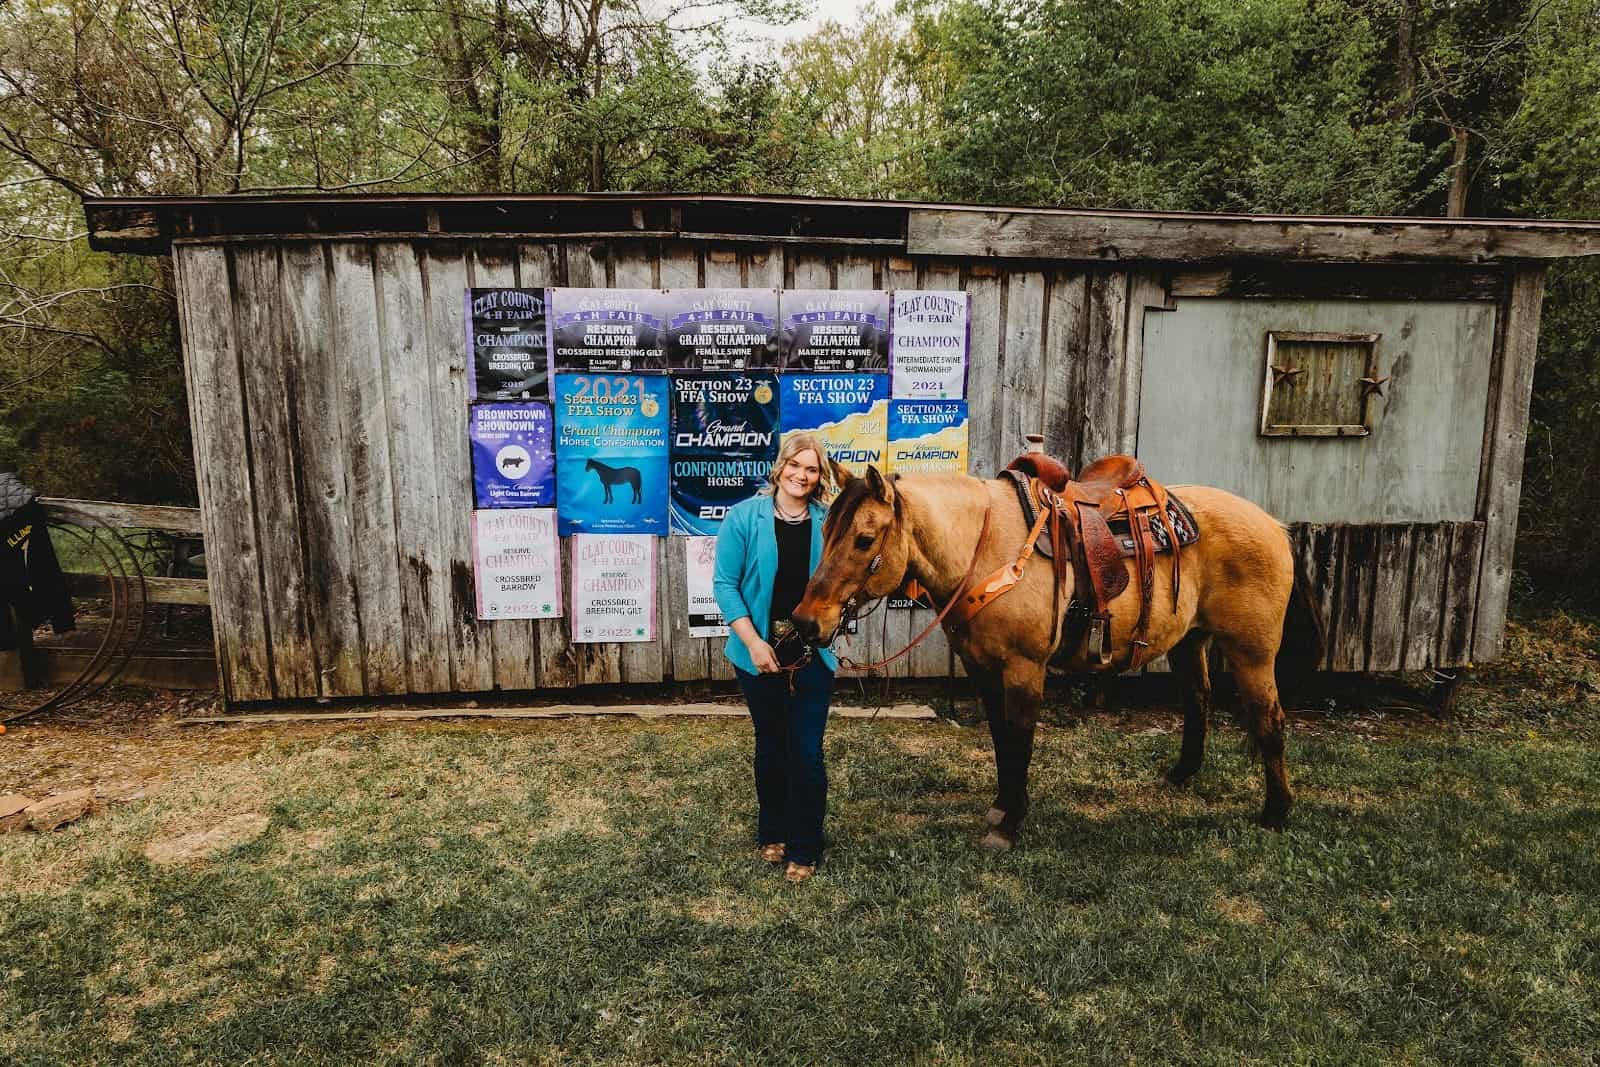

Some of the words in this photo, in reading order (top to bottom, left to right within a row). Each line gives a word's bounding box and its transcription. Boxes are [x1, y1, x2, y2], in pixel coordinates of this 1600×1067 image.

[474, 292, 498, 315] CLAY
[501, 290, 543, 315] COUNTY
[898, 297, 921, 318] CLAY
[924, 296, 963, 316] COUNTY
[484, 310, 503, 320] 4-H
[507, 310, 533, 320] FAIR
[574, 311, 600, 320] 4-H
[609, 311, 643, 321] FAIR
[688, 311, 713, 321] 4-H
[721, 311, 754, 321] FAIR
[801, 313, 825, 322] 4-H
[835, 312, 866, 322] FAIR
[928, 314, 952, 323] FAIR
[586, 324, 633, 334] RESERVE
[700, 324, 745, 334] RESERVE
[812, 325, 857, 334] RESERVE
[477, 334, 544, 347] CHAMPION
[583, 335, 636, 346] CHAMPION
[679, 334, 712, 346] GRAND
[716, 334, 767, 346] CHAMPION
[809, 335, 860, 346] CHAMPION
[898, 336, 960, 348] CHAMPION
[492, 353, 530, 361] CROSSBRED
[557, 348, 604, 356] CROSSBRED
[606, 349, 645, 357] BREEDING
[646, 349, 664, 357] GILT
[695, 348, 726, 356] FEMALE
[726, 348, 752, 356] SWINE
[798, 348, 830, 356] MARKET
[897, 356, 940, 364] INTERMEDIATE
[940, 356, 961, 364] SWINE
[488, 361, 521, 371] BREEDING
[522, 361, 535, 371] GILT
[575, 377, 645, 400] 2021
[735, 378, 752, 390] 23
[793, 378, 854, 391] SECTION
[858, 379, 874, 391] 23
[912, 382, 944, 390] 2021
[622, 394, 637, 405] 23
[680, 390, 705, 402] FFA
[709, 391, 749, 403] SHOW
[799, 392, 824, 404] FFA
[827, 392, 870, 404] SHOW
[568, 405, 592, 416] FFA
[597, 406, 634, 416] SHOW
[897, 404, 943, 414] SECTION
[945, 404, 959, 414] 23
[478, 409, 546, 420] BROWNSTOWN
[901, 414, 920, 424] FFA
[922, 414, 956, 424] SHOW
[478, 421, 534, 431] SHOWDOWN
[562, 424, 600, 436] Grand
[602, 424, 661, 438] Champion
[706, 420, 748, 437] Grand
[675, 432, 772, 446] CHAMPION
[827, 449, 880, 462] MPION
[896, 450, 959, 460] CHAMPION
[674, 461, 775, 477] CONFORMATION
[707, 477, 744, 487] HORSE
[582, 541, 604, 560] CLAY
[608, 540, 646, 560] COUNTY
[495, 575, 541, 583] CROSSBRED
[501, 584, 536, 592] BARROW
[583, 578, 646, 592] CHAMPION
[692, 596, 715, 604] CROSS
[892, 600, 913, 608] 2024
[585, 608, 625, 616] BREEDING
